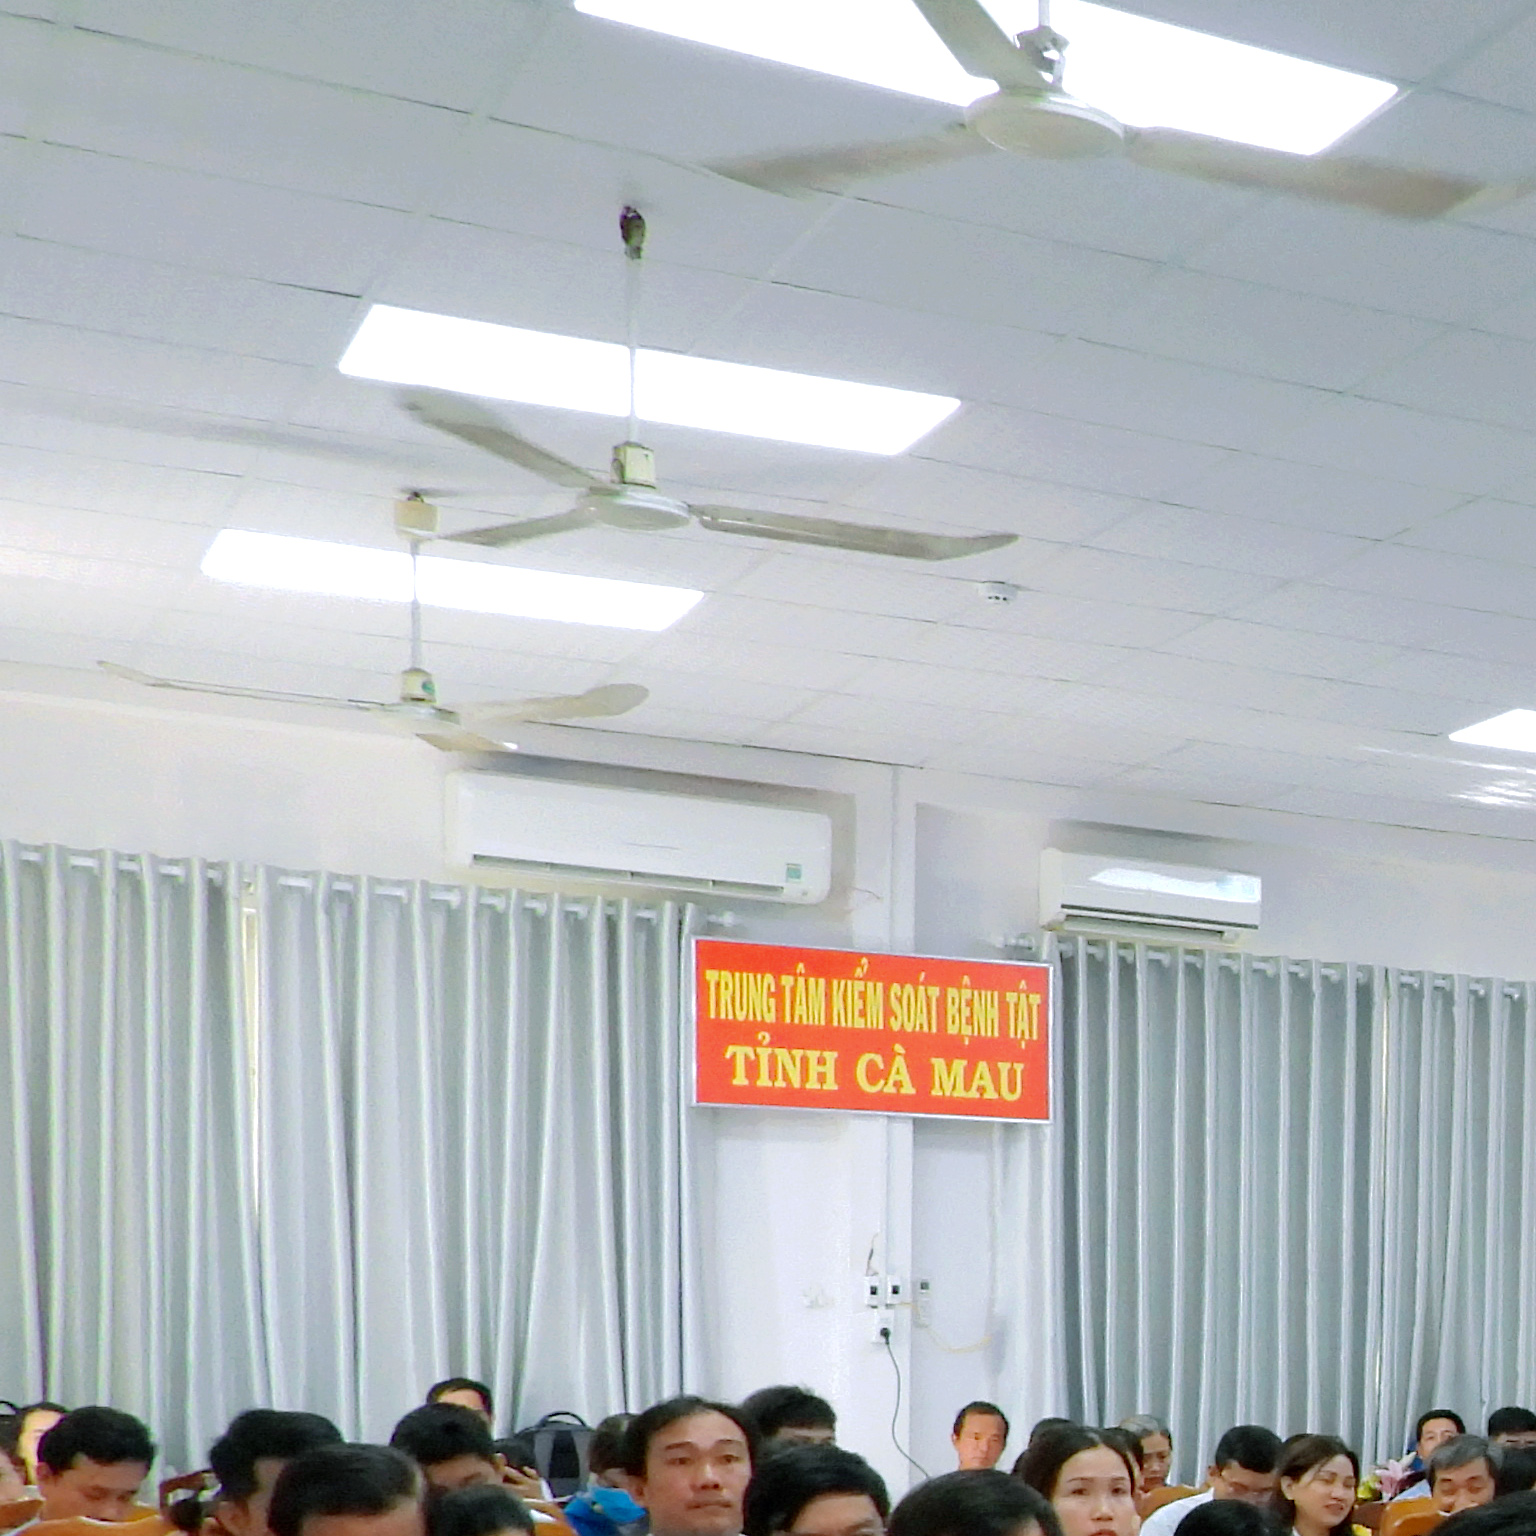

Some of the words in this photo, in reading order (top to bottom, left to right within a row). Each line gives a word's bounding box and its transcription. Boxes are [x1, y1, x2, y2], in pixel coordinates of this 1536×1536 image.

[705, 969, 776, 1023] TRUNG
[780, 962, 826, 1026] TÂM
[832, 957, 884, 1029] KIỂM
[889, 972, 940, 1033] SOÁT
[947, 975, 999, 1047] BỆNH
[1006, 980, 1041, 1049] TẬT
[724, 1031, 838, 1091] TỈNH
[856, 1043, 916, 1095] CÀ
[931, 1058, 1024, 1101] MAU
